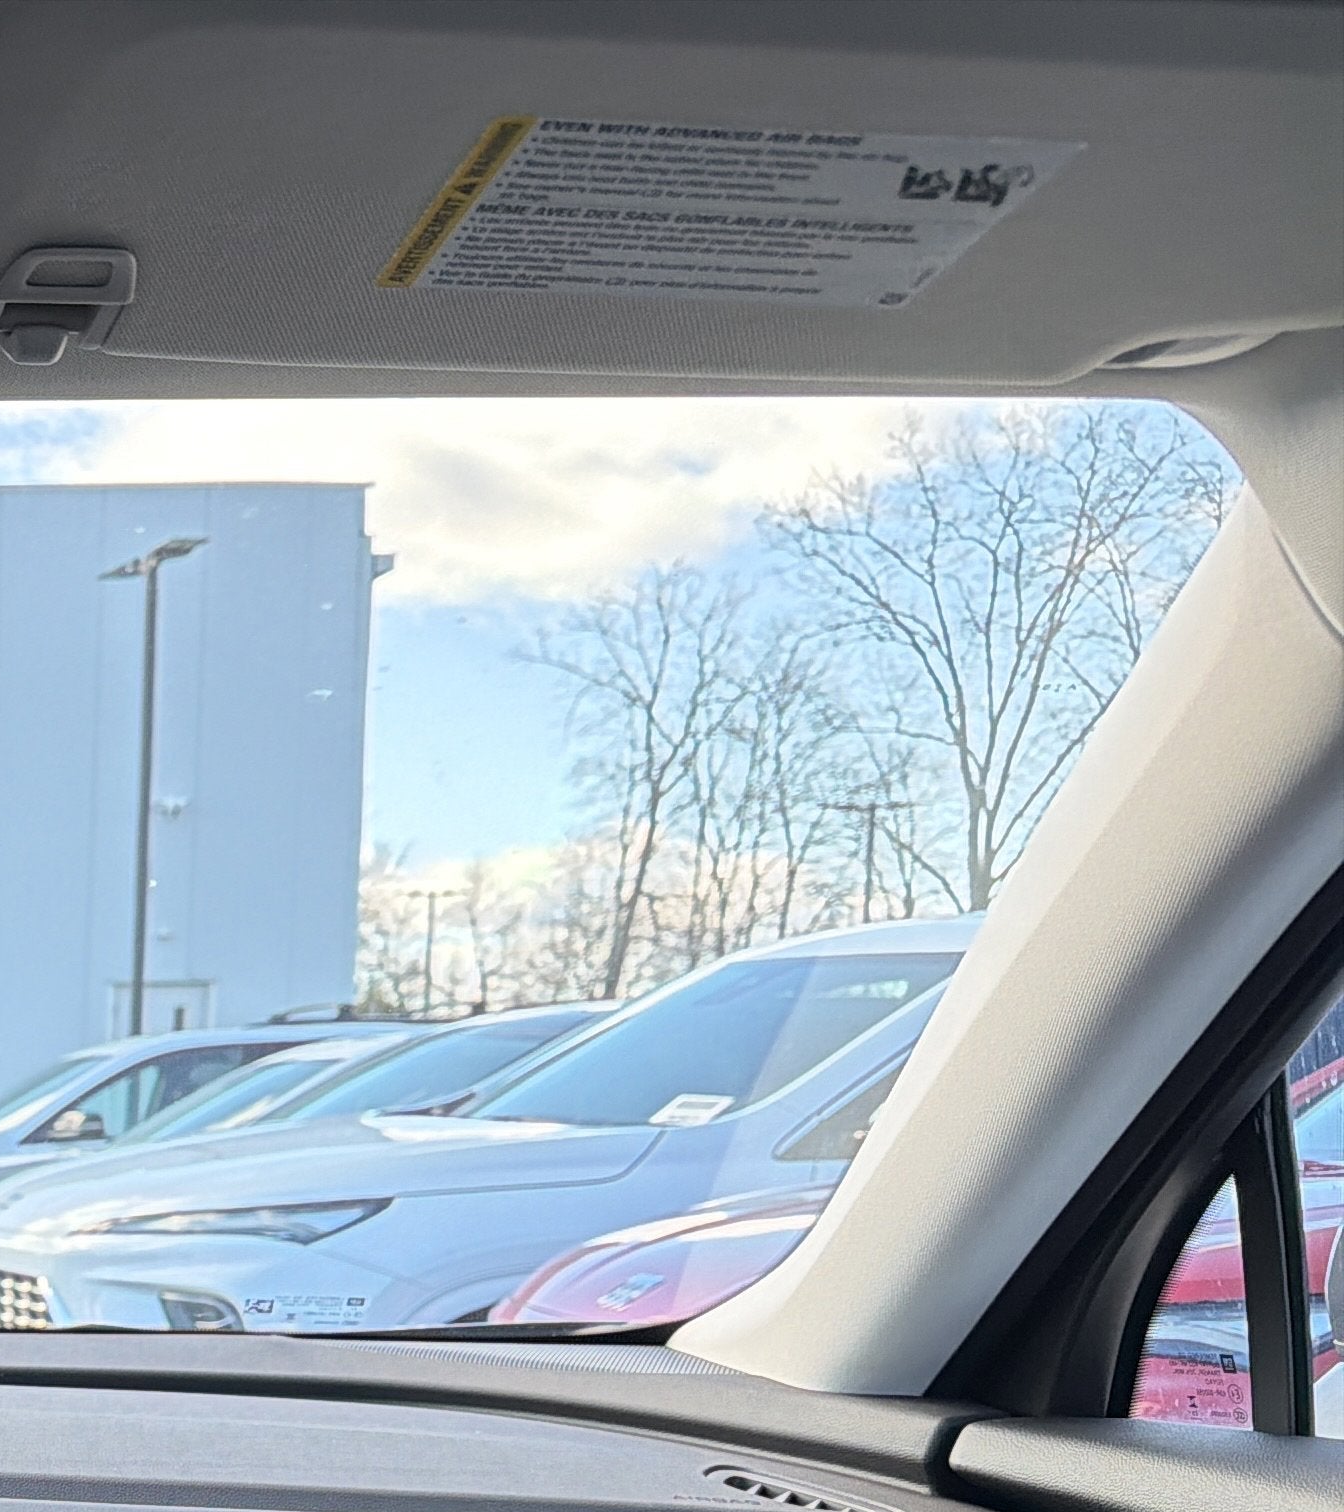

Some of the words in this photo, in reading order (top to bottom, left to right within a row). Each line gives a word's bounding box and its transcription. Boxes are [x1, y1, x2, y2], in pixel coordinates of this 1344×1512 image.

[540, 119, 593, 133] EVEN
[598, 121, 649, 136] WITH
[766, 131, 802, 145] AIR
[534, 206, 581, 219] AVEC
[584, 208, 621, 222] DES
[624, 210, 669, 223] SACS
[388, 196, 466, 283] AVERTISSEMENT
